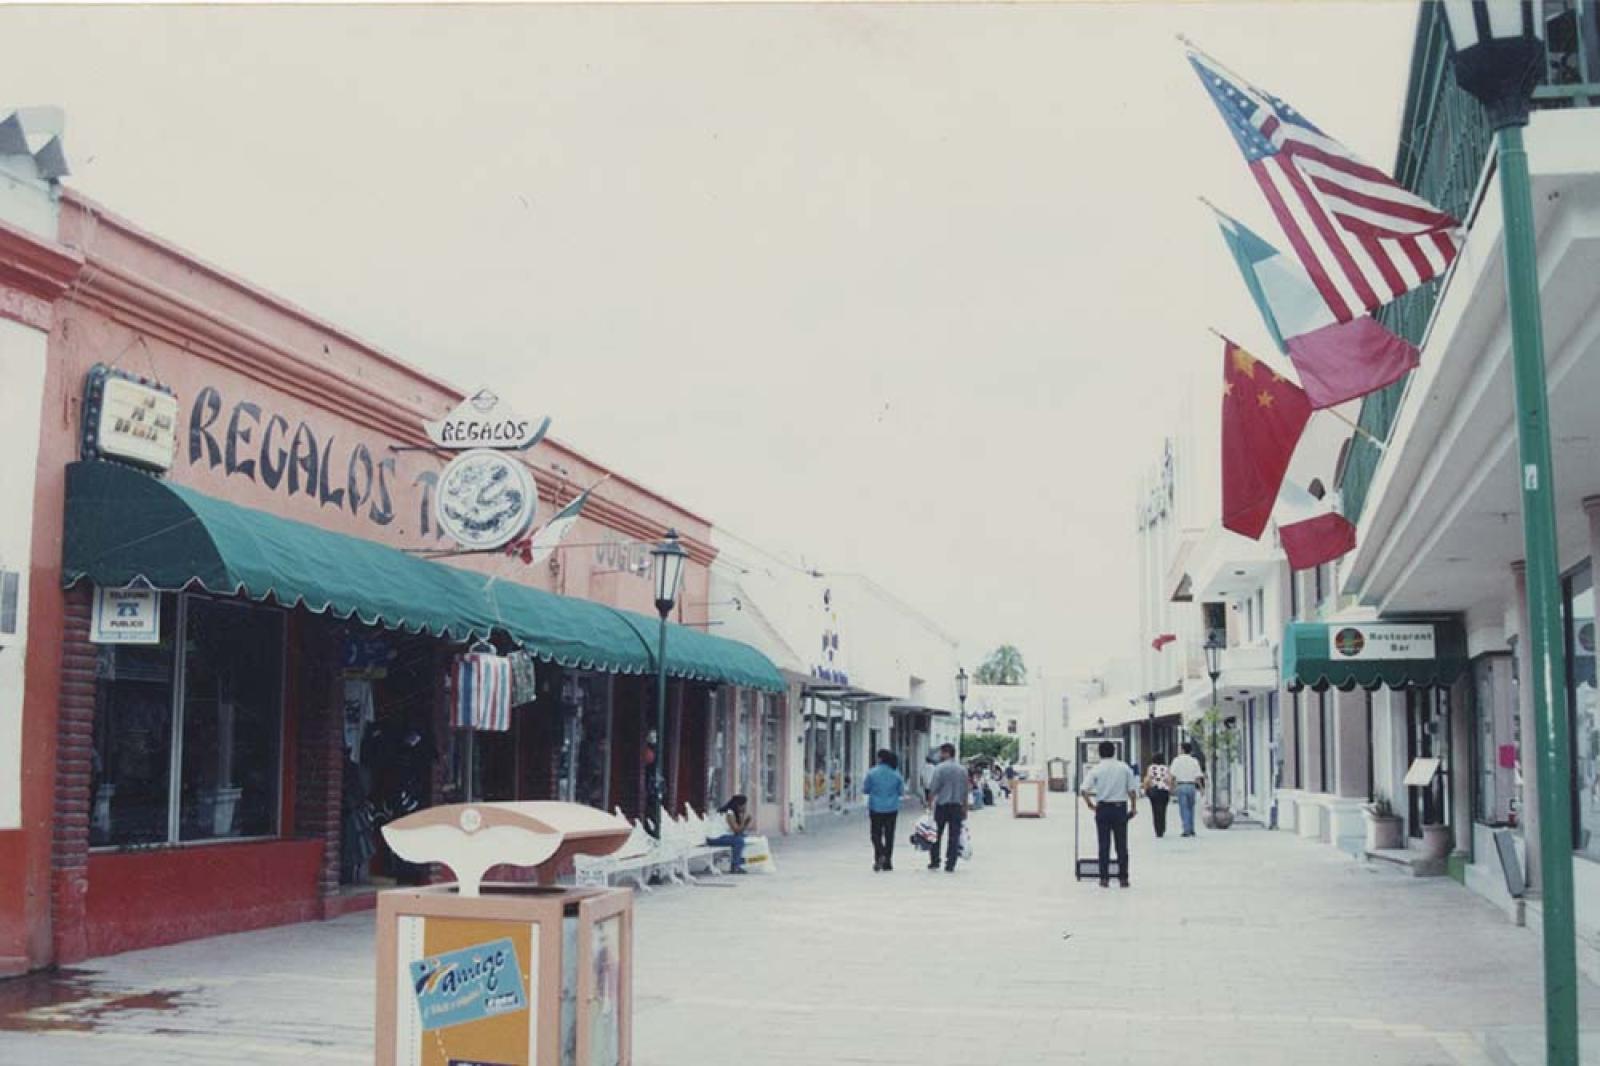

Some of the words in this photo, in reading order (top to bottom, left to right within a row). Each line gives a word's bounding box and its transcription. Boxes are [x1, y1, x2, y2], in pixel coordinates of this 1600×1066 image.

[441, 420, 528, 442] REGALOS
[188, 385, 397, 526] REGALOS
[1369, 631, 1433, 641] Restaurant
[1390, 643, 1409, 652] Bar
